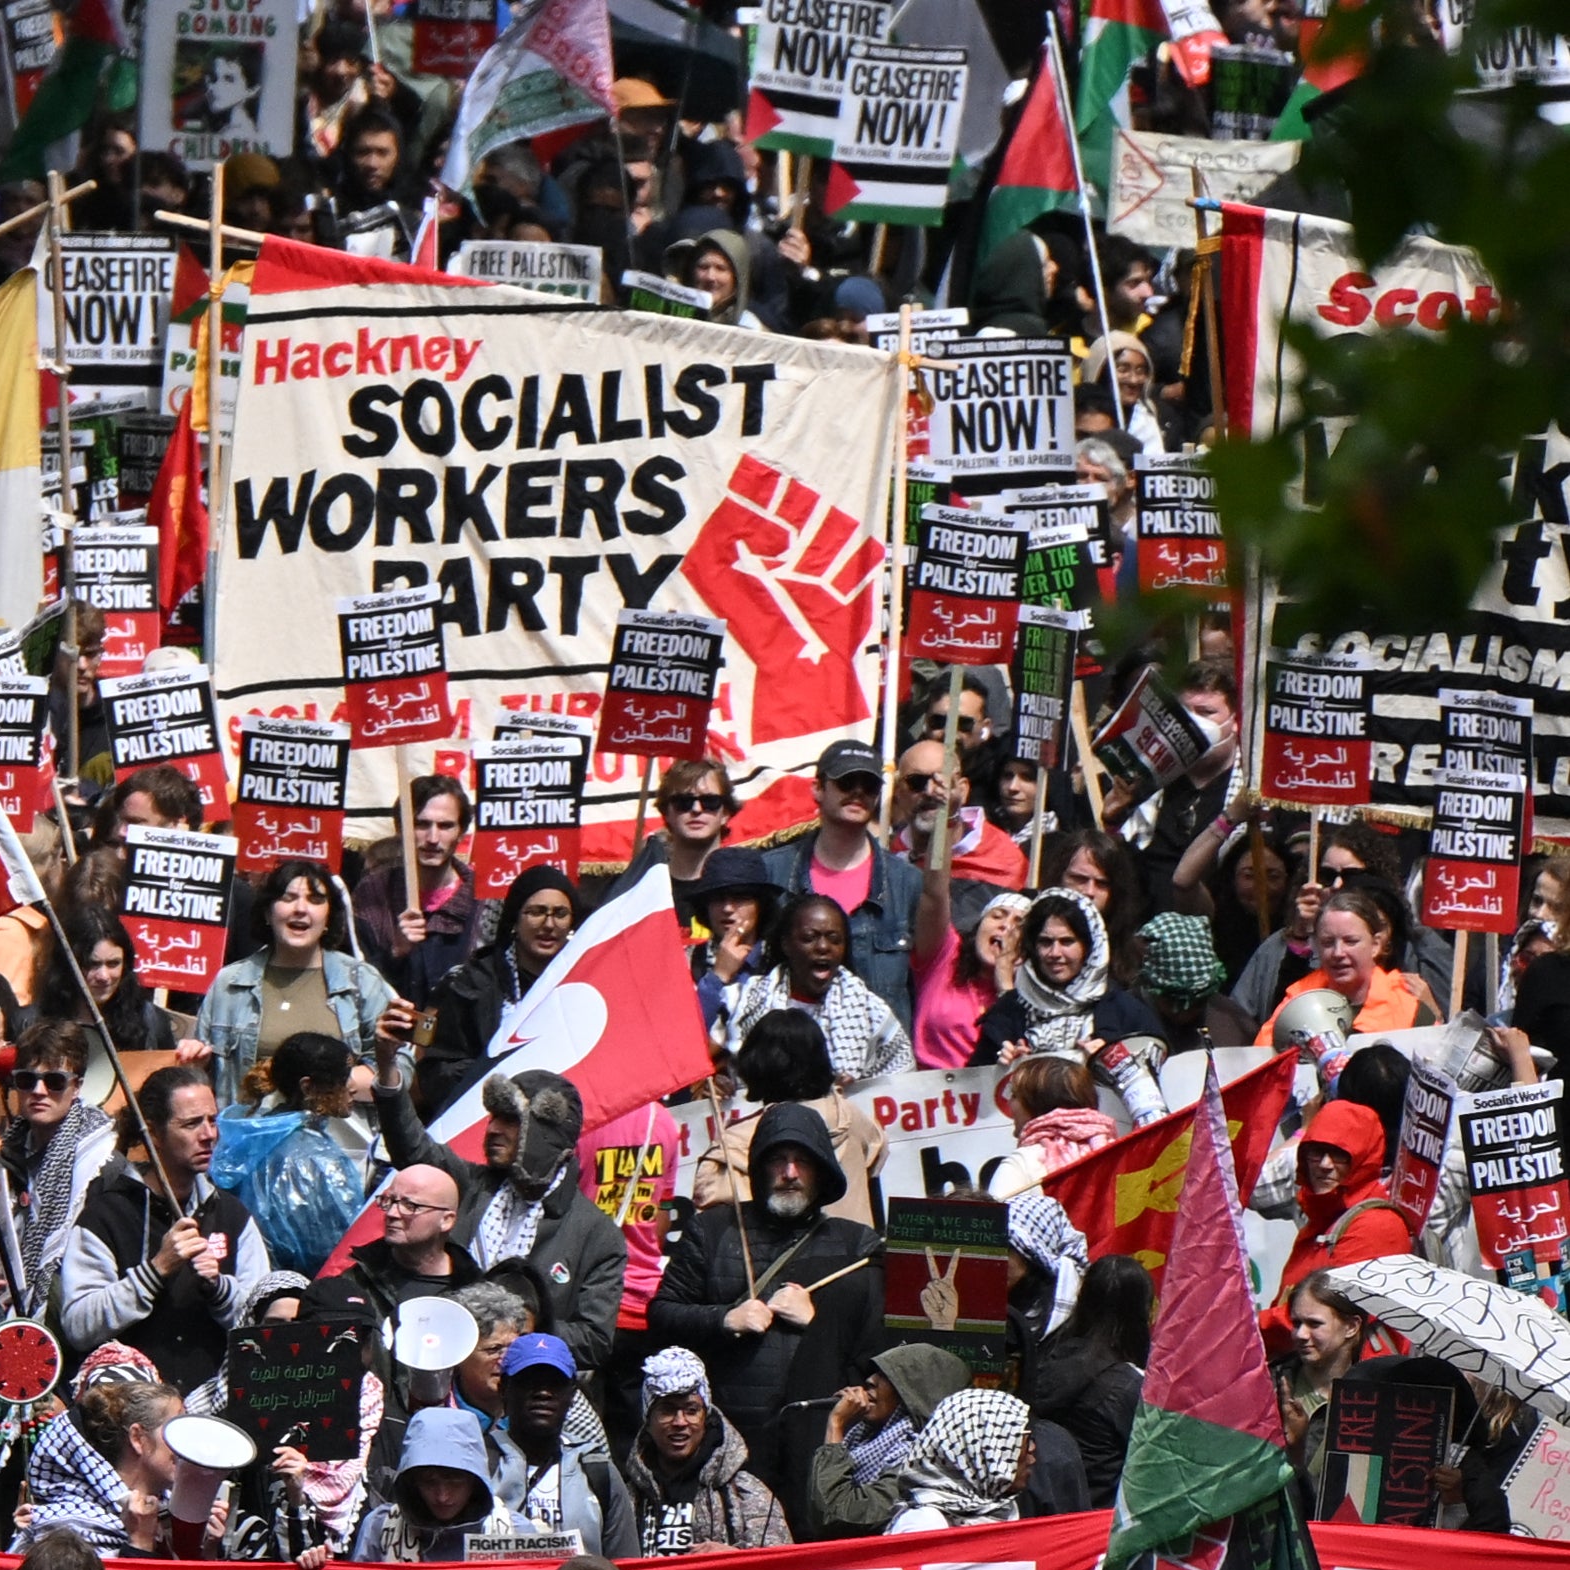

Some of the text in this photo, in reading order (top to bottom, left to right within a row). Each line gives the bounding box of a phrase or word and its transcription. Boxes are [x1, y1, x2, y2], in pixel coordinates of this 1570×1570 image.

[177, 11, 277, 38] BOMBING
[851, 63, 961, 101] CEASEFIRE
[855, 99, 947, 148] NOW!
[469, 250, 592, 279] FREE PALESTINE
[254, 328, 484, 386] Hackney
[341, 363, 777, 458] SOCIALIST
[951, 399, 1059, 454] NOW!
[234, 455, 688, 560] WORKERS
[622, 630, 711, 660] FREEDOM
[611, 664, 710, 696] PALESTINE
[1276, 670, 1363, 699] FREEDOM
[1269, 705, 1367, 736] PALESTINE
[1448, 712, 1522, 745] FREEDOM
[249, 738, 338, 769] FREEDOM
[1445, 750, 1527, 776] PALESTINE
[242, 774, 339, 806] PALESTINE
[485, 761, 571, 788] FREEDOM
[480, 799, 575, 826] PALESTINE
[1438, 791, 1513, 822] FREEDOM
[1432, 829, 1515, 860] PALESTINE
[873, 1087, 981, 1132] Party
[469, 1536, 578, 1551] FIGHT RACISM!
